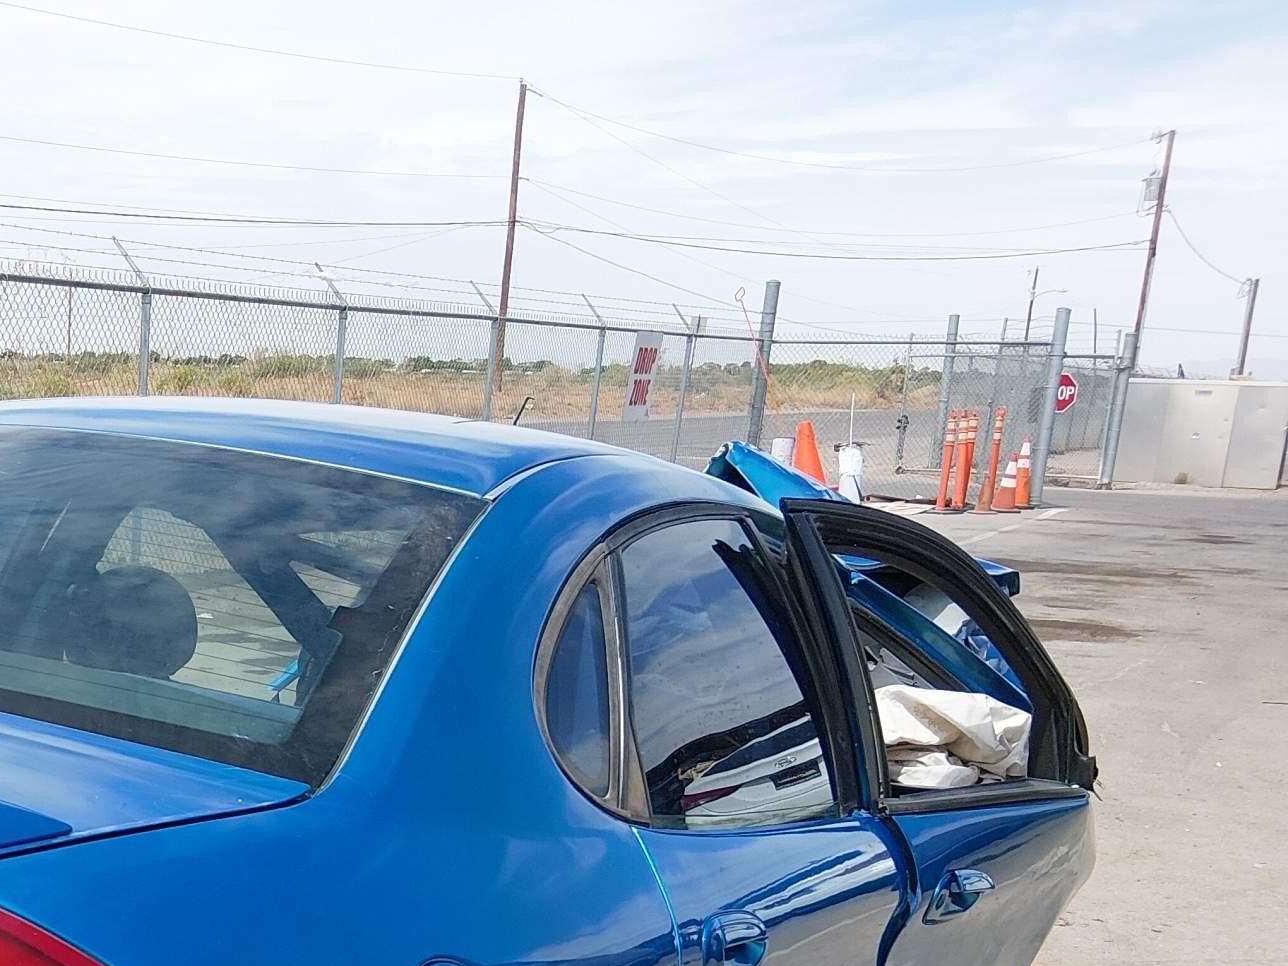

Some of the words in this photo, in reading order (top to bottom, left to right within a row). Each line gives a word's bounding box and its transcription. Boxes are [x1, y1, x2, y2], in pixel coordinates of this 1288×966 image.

[634, 347, 658, 375] DROP
[629, 379, 651, 406] ZONE
[1057, 385, 1075, 400] OP
